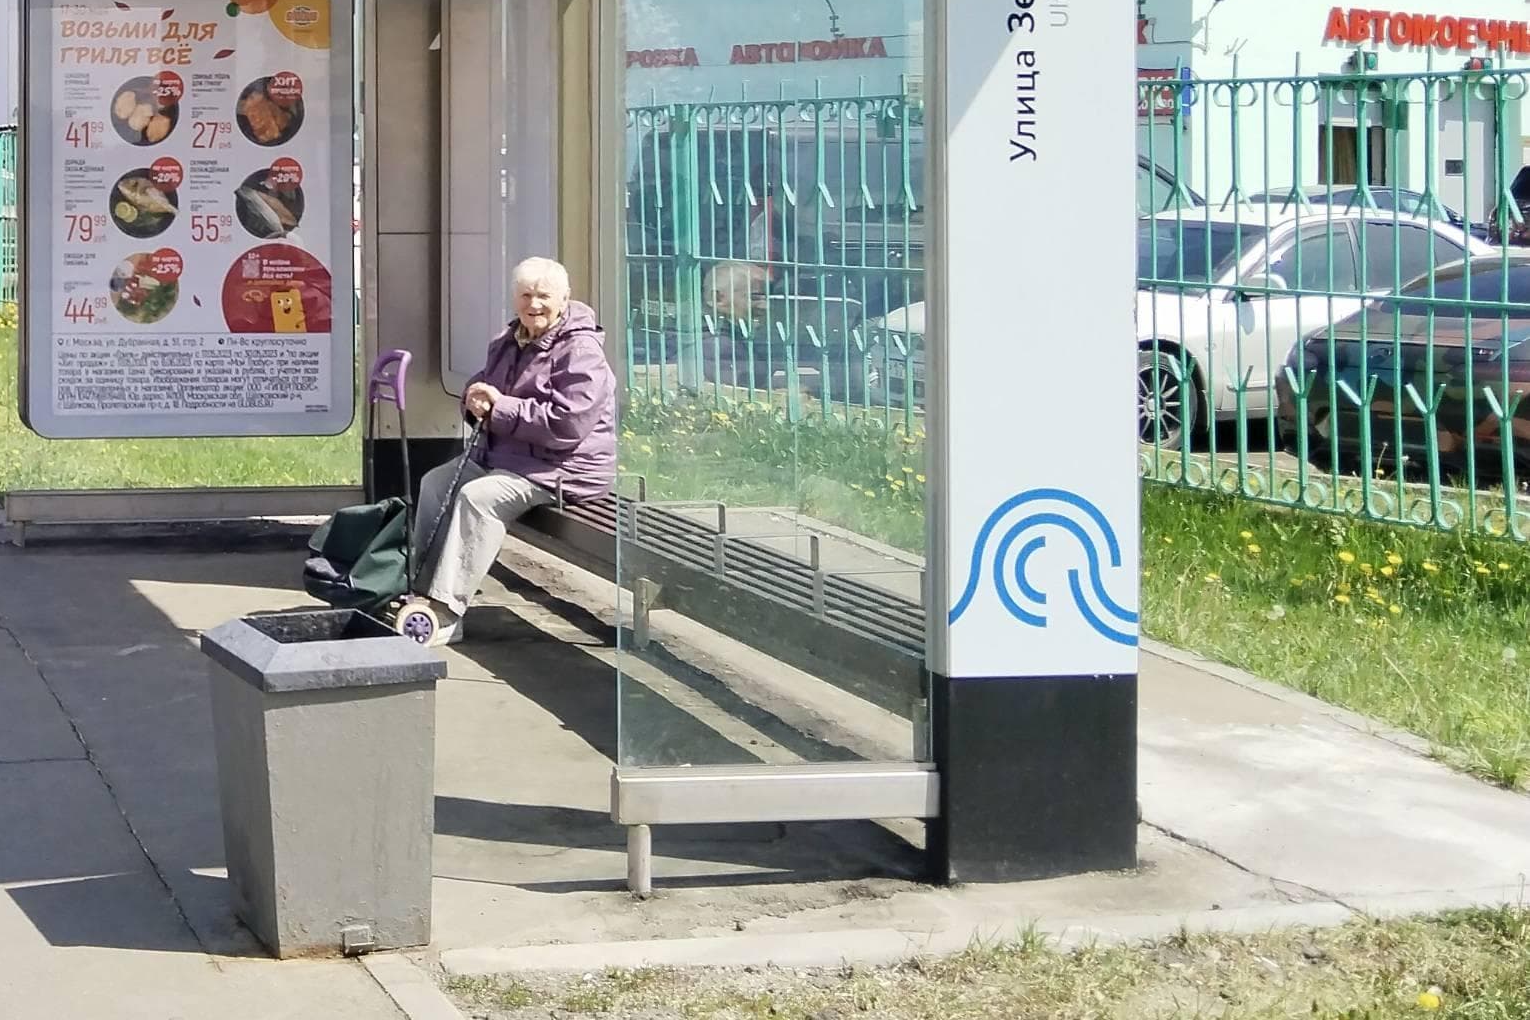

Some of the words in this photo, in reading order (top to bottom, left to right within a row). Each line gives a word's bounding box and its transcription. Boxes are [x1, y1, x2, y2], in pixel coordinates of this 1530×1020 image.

[60, 20, 157, 39] ВОЗЬМИ
[161, 22, 218, 42] ДЛЯ
[60, 46, 141, 65] ГРИЛЯ
[147, 43, 192, 65] ВСЁ
[274, 77, 298, 87] ХИТ
[1009, 49, 1040, 162] Улица
[65, 121, 88, 148] 41
[192, 121, 218, 148] 27
[64, 215, 93, 242] 79
[191, 215, 219, 242] 55
[64, 297, 95, 323] 44
